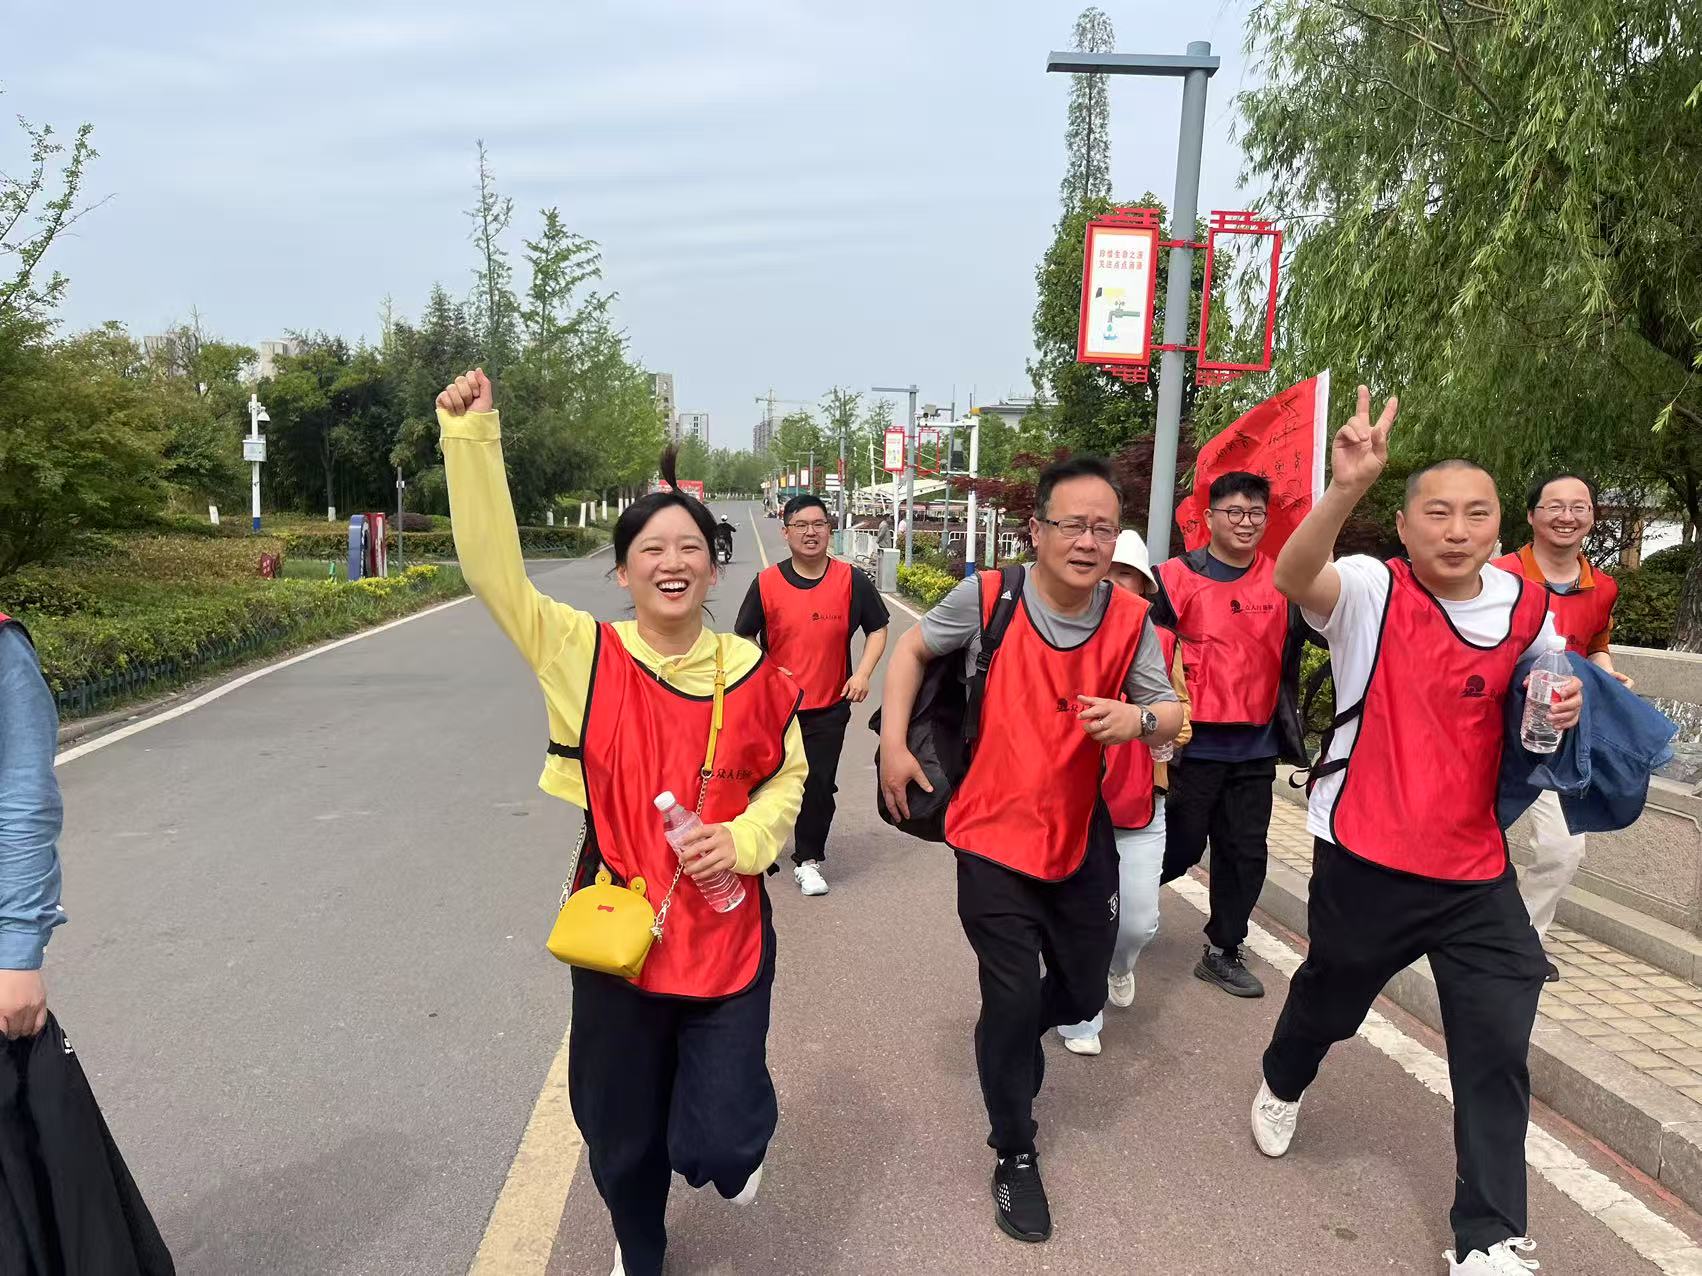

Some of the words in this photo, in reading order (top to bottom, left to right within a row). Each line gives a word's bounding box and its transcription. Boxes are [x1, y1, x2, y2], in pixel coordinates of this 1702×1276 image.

[1098, 260, 1143, 270] 关注点点滴滴
